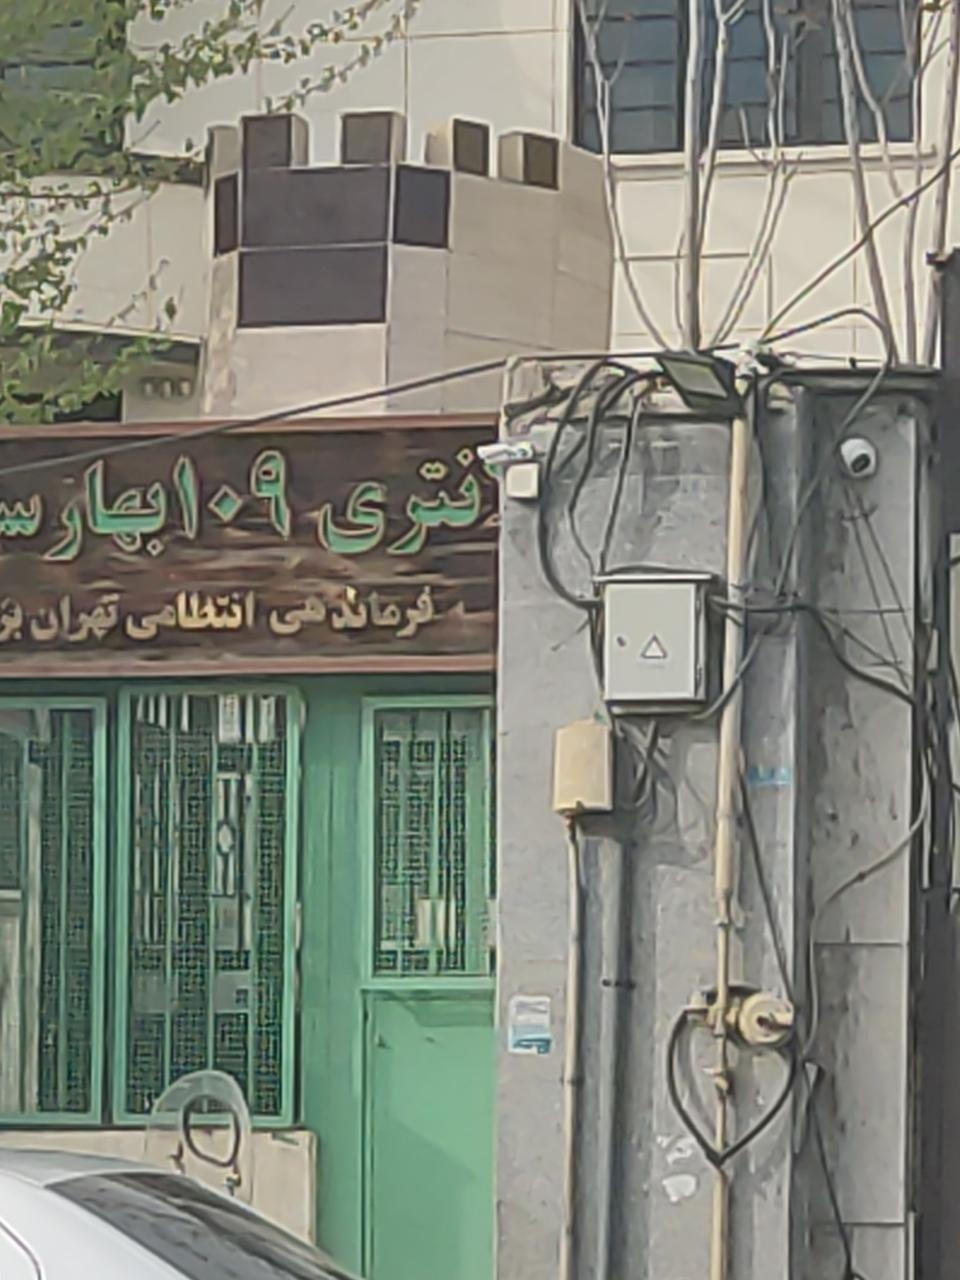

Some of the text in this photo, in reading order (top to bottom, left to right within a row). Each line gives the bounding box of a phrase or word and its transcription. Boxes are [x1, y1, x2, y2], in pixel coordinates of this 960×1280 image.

[173, 452, 291, 541] ۱۰۹
[30, 592, 121, 643] تهران
[126, 589, 256, 641] انتظامی
[269, 585, 437, 638] فرماندهی
